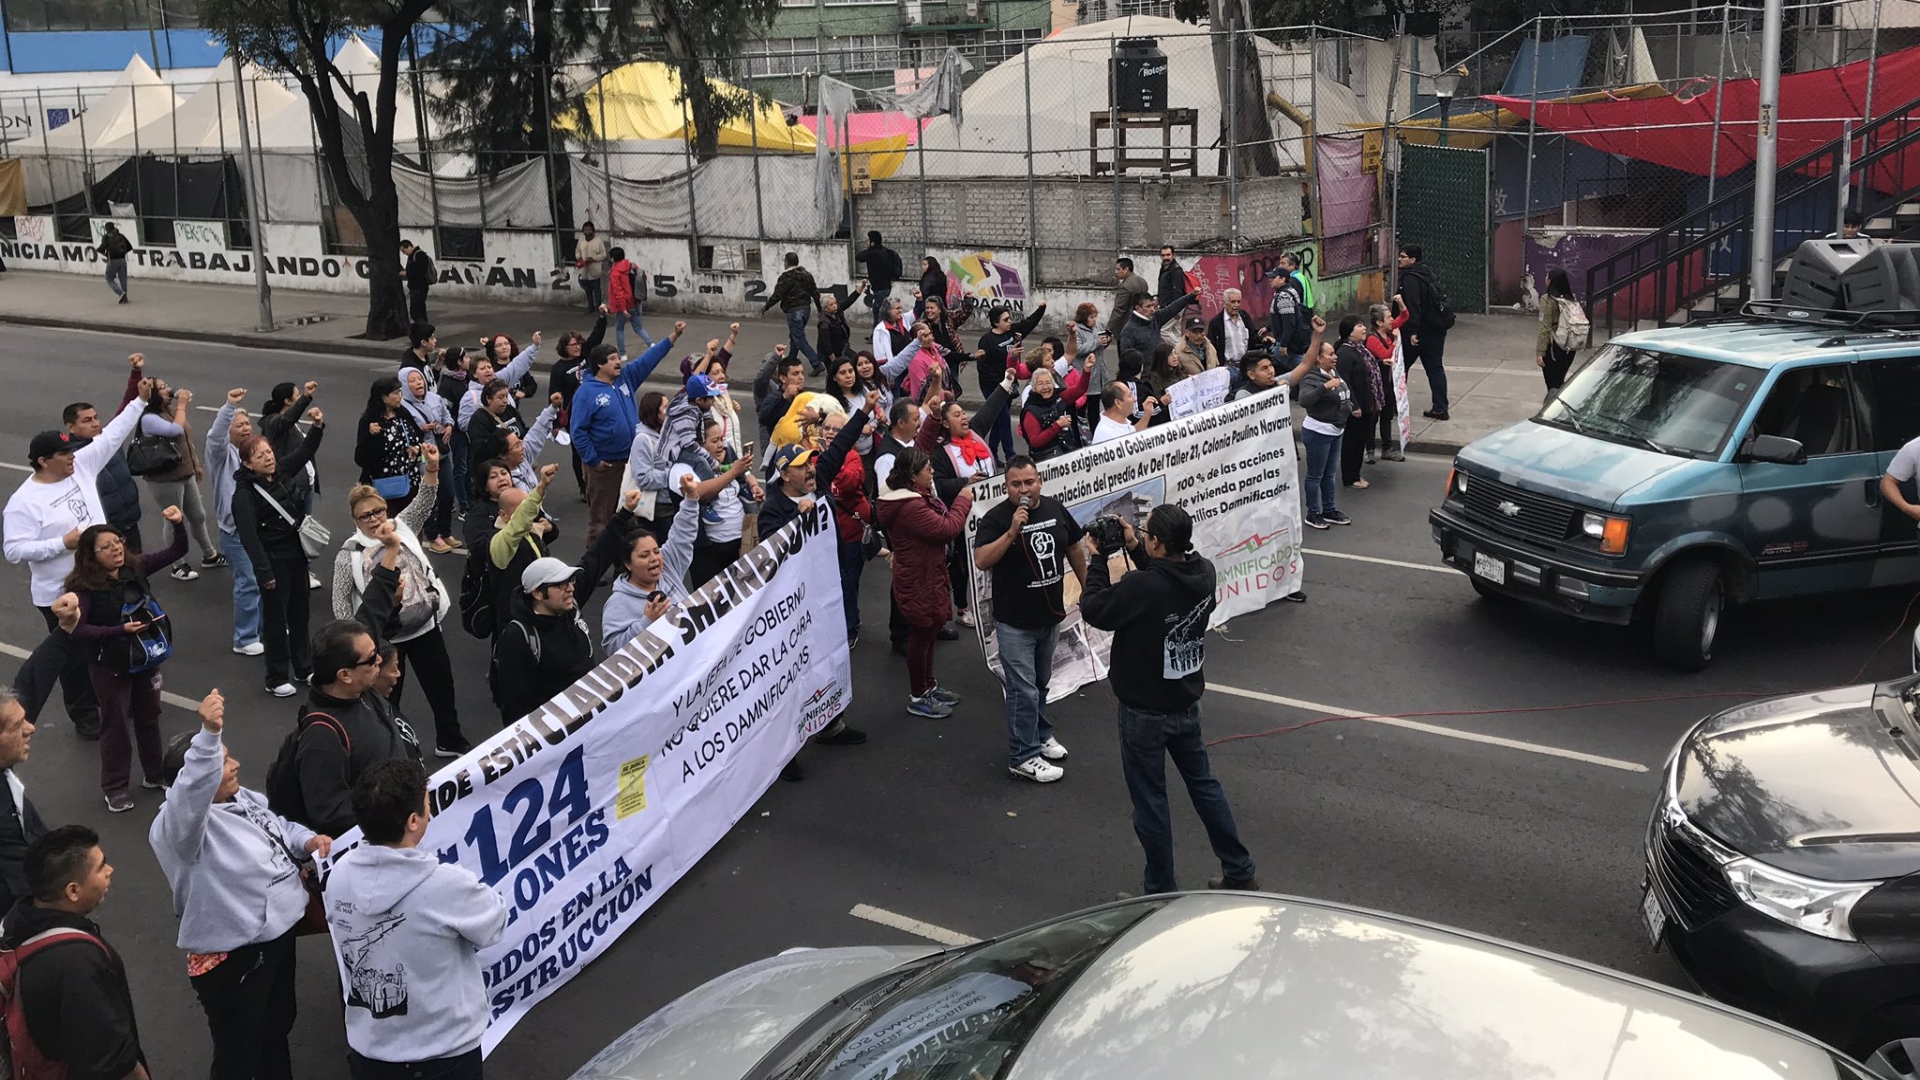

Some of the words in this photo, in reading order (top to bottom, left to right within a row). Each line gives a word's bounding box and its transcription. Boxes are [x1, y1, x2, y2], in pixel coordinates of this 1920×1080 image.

[132, 249, 341, 278] TRABAJANDO
[979, 482, 989, 501] 21
[1071, 450, 1116, 477] exigiendo
[1116, 444, 1126, 461] al
[1124, 432, 1166, 456] Gobierno
[1166, 428, 1179, 443] de
[1178, 425, 1188, 439] la
[1186, 414, 1218, 435] Ciudad
[1217, 404, 1250, 428] solución
[1250, 405, 1256, 415] a
[1255, 392, 1286, 412] nuestra
[1093, 473, 1108, 493] del
[1107, 464, 1136, 492] predio
[1136, 462, 1150, 477] Av
[1149, 453, 1165, 473] Del
[1165, 447, 1190, 468] Taller
[1201, 435, 1231, 456] Colonia
[1231, 422, 1260, 445] Paulino
[1176, 475, 1196, 492] 100
[1194, 472, 1206, 484] %
[1207, 467, 1220, 481] de
[1220, 462, 1238, 476] las
[1238, 446, 1286, 470] acciones
[1175, 497, 1190, 512] de
[1190, 479, 1238, 502] vivienda
[1238, 475, 1263, 493] para
[1263, 466, 1281, 481] las
[1219, 482, 1291, 514] Damnificados.
[1216, 542, 1300, 586] AMNIFICADOS
[477, 723, 543, 786] ESTÁ
[527, 629, 676, 747] CLAUDIA
[664, 502, 830, 647] SHEINBAUM?
[672, 695, 684, 719] Y
[686, 680, 703, 709] LA
[744, 581, 806, 646] GOBIERNO
[660, 725, 685, 758] NO
[686, 676, 740, 733] QUIERE
[738, 653, 772, 692] DAR
[771, 640, 789, 667] LA
[788, 609, 813, 649] CARA
[682, 759, 695, 784] A
[694, 731, 725, 771] LOS
[725, 645, 810, 744] DAMNIFICADOS
[560, 882, 595, 931] EN
[598, 855, 633, 898] LA
[486, 863, 654, 1029] STRUCCIÓN
